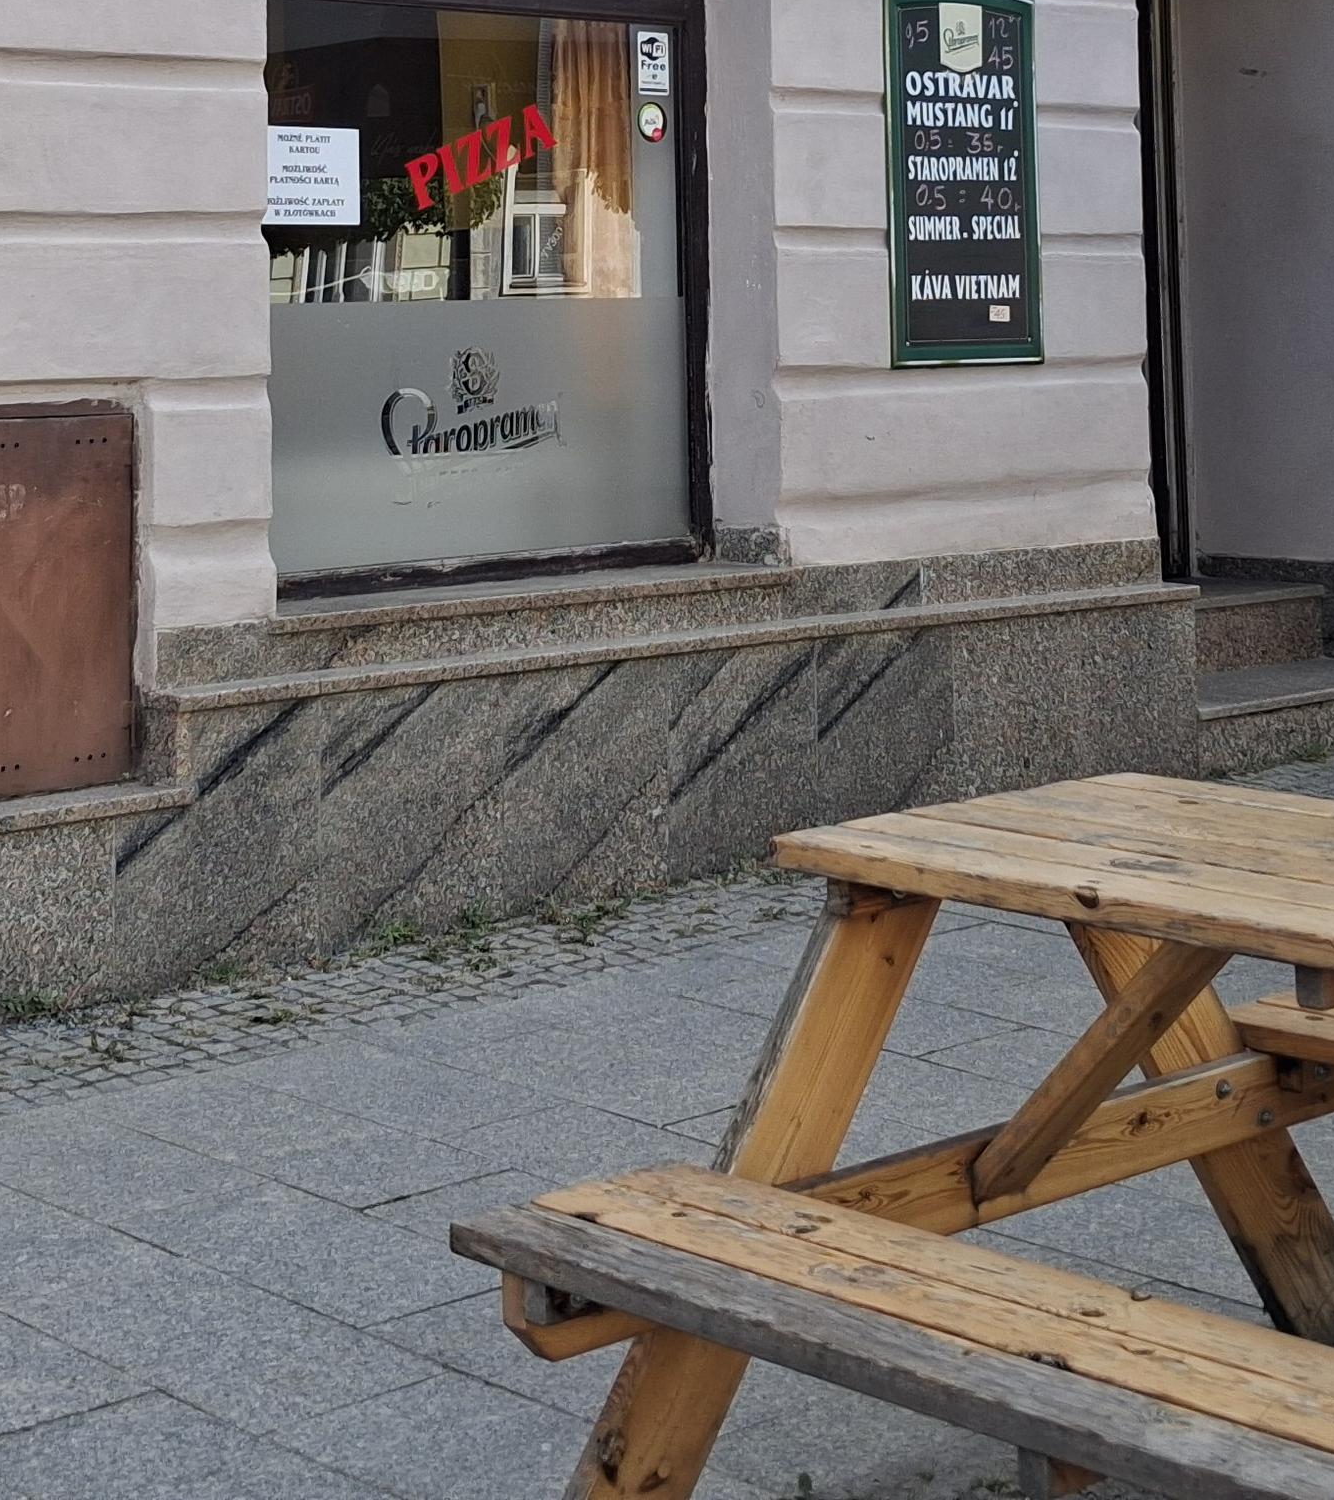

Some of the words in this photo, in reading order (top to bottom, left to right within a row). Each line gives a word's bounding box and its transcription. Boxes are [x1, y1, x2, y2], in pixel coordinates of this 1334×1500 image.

[641, 59, 666, 71] Free
[988, 45, 1014, 70] 45
[905, 70, 1016, 100] OSTRAVAR
[906, 100, 993, 128] MUSTANG
[914, 129, 941, 152] 0,5
[403, 103, 558, 212] PIZZA
[908, 155, 999, 181] STAROPRAMEN
[971, 215, 1021, 240] SPECIAL
[955, 274, 1020, 300] VIETNAM
